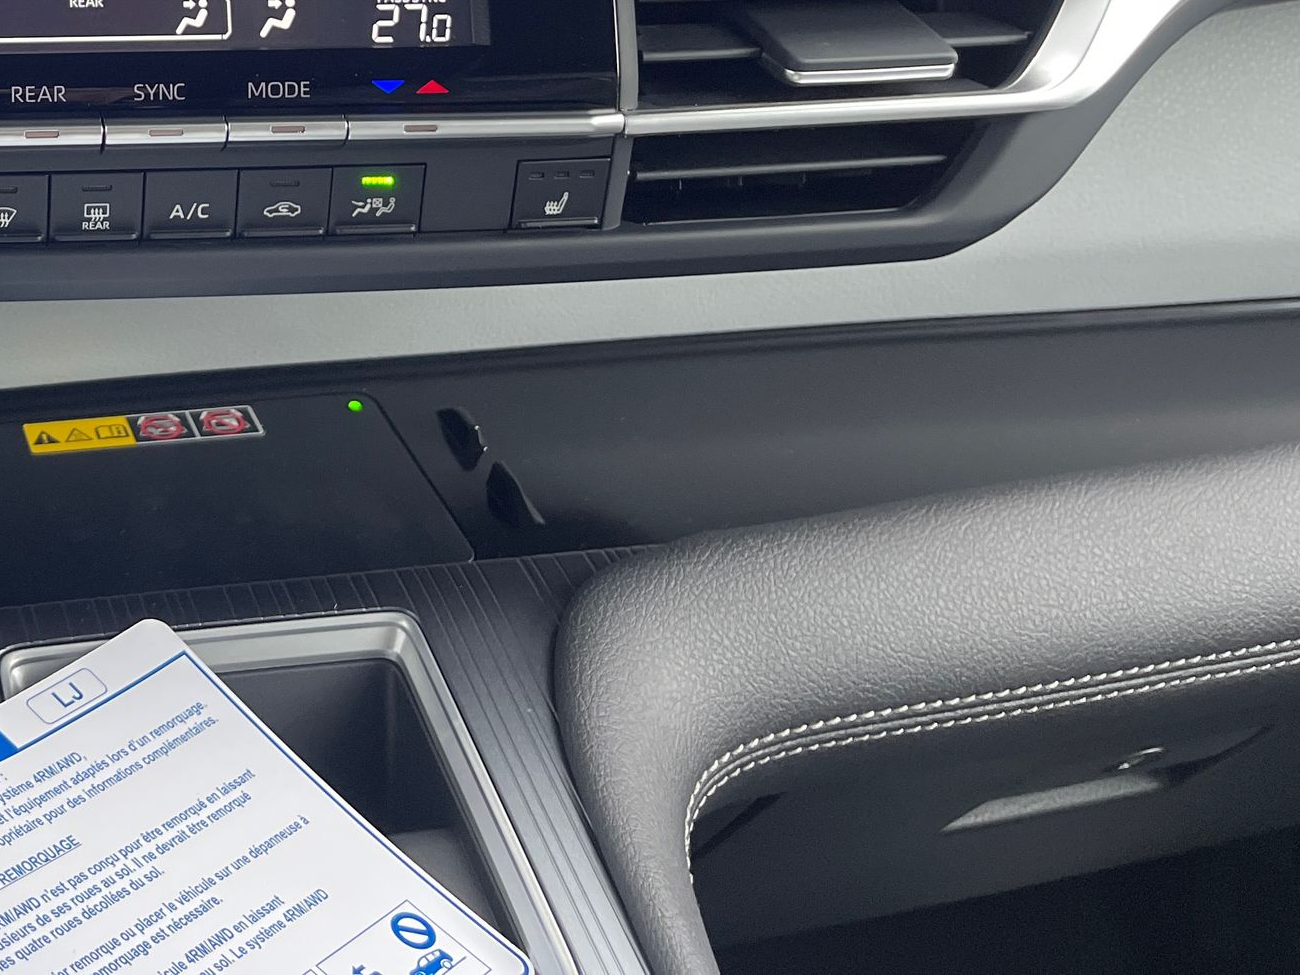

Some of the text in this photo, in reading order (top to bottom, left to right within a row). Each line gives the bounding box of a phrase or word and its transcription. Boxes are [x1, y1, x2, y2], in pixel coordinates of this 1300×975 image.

[372, 4, 452, 43] 27.0
[10, 86, 66, 103] REAR
[133, 83, 186, 101] SYNC
[247, 81, 310, 99] MODE
[169, 203, 209, 220] A/C
[82, 221, 110, 230] REAR
[51, 682, 84, 708] LJ
[3, 779, 73, 820] l'équipement
[69, 759, 110, 786] adaptés
[105, 748, 130, 764] lors
[127, 735, 152, 752] d'un
[149, 702, 207, 739] remorquage.
[32, 752, 87, 784] 4RM/AWD,
[42, 804, 68, 825] pour
[66, 794, 87, 809] des
[82, 761, 144, 799] informations
[141, 716, 219, 765] complémentaires.
[14, 934, 52, 961] quatre
[49, 916, 83, 939] roues
[81, 887, 131, 920] décollées
[129, 877, 146, 891] du
[143, 865, 165, 882] sol.
